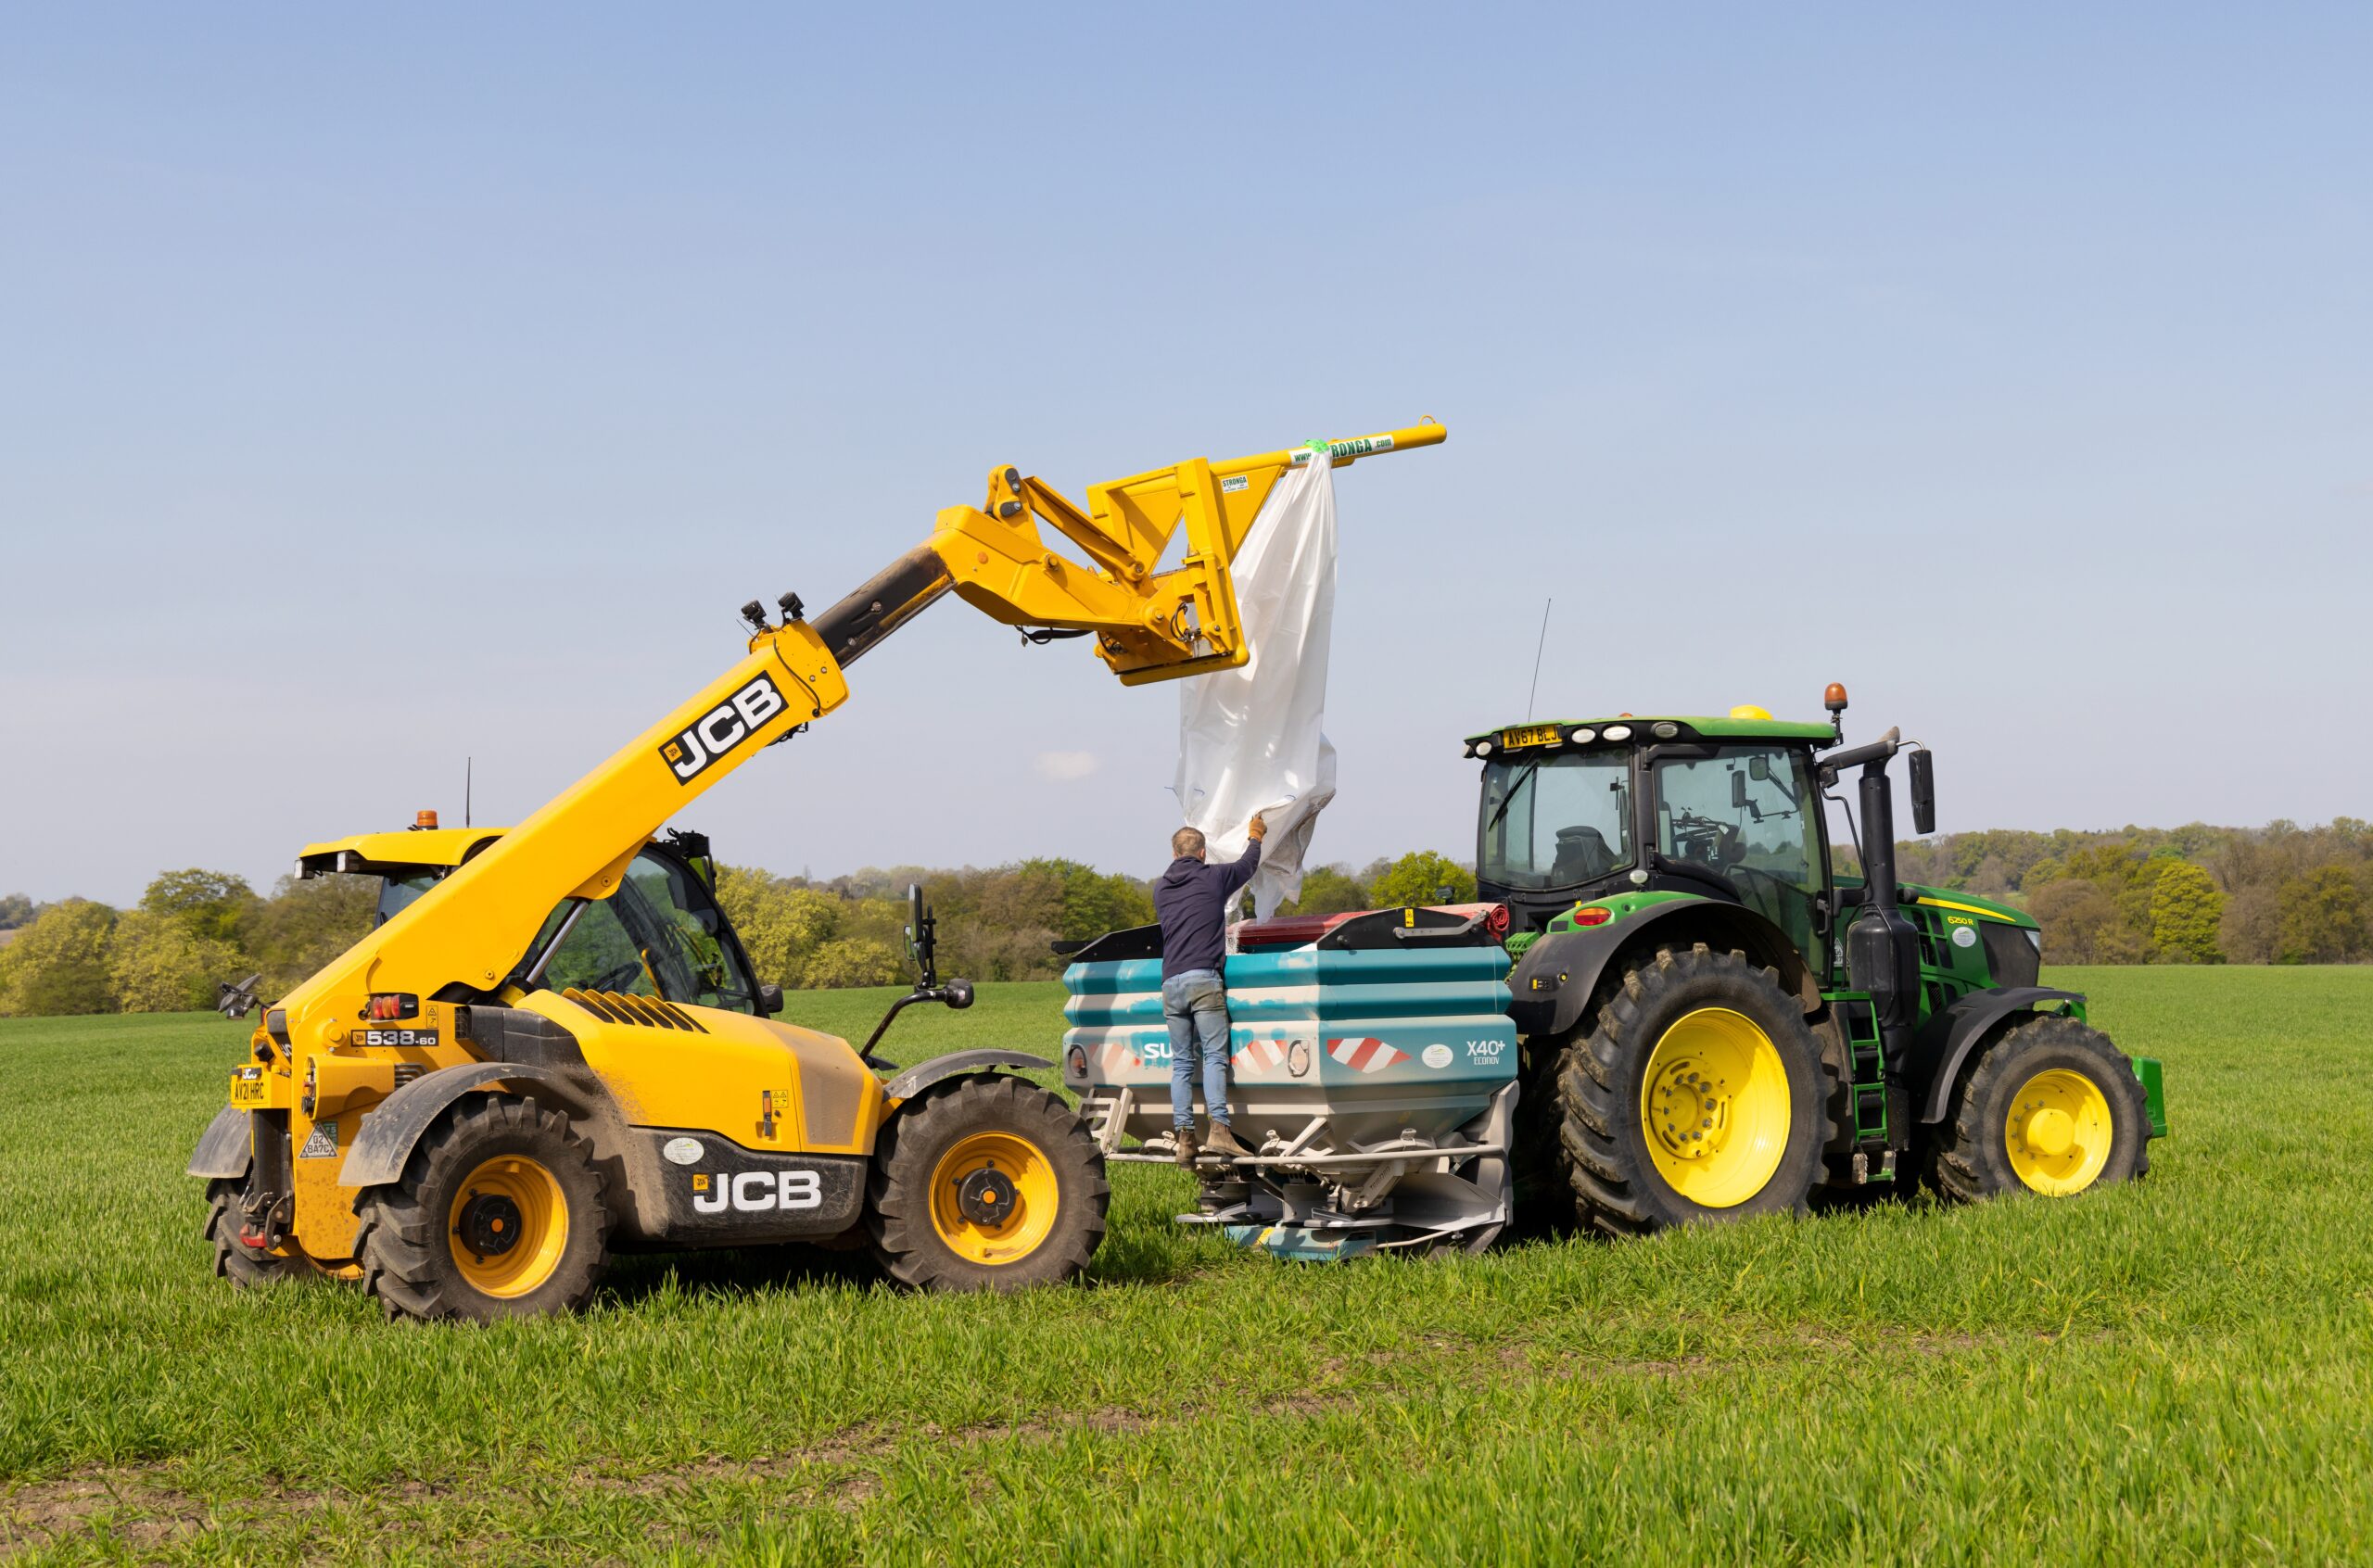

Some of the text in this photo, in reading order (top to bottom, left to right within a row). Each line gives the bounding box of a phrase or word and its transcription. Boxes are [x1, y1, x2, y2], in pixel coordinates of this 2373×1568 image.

[1330, 438, 1372, 458] RONGA
[1223, 476, 1247, 487] STRONGA
[674, 678, 782, 778] JCB
[1508, 728, 1534, 746] AV67
[1466, 1040, 1506, 1056] X40+
[235, 1082, 248, 1101] AV21
[693, 1170, 822, 1213] JCB
